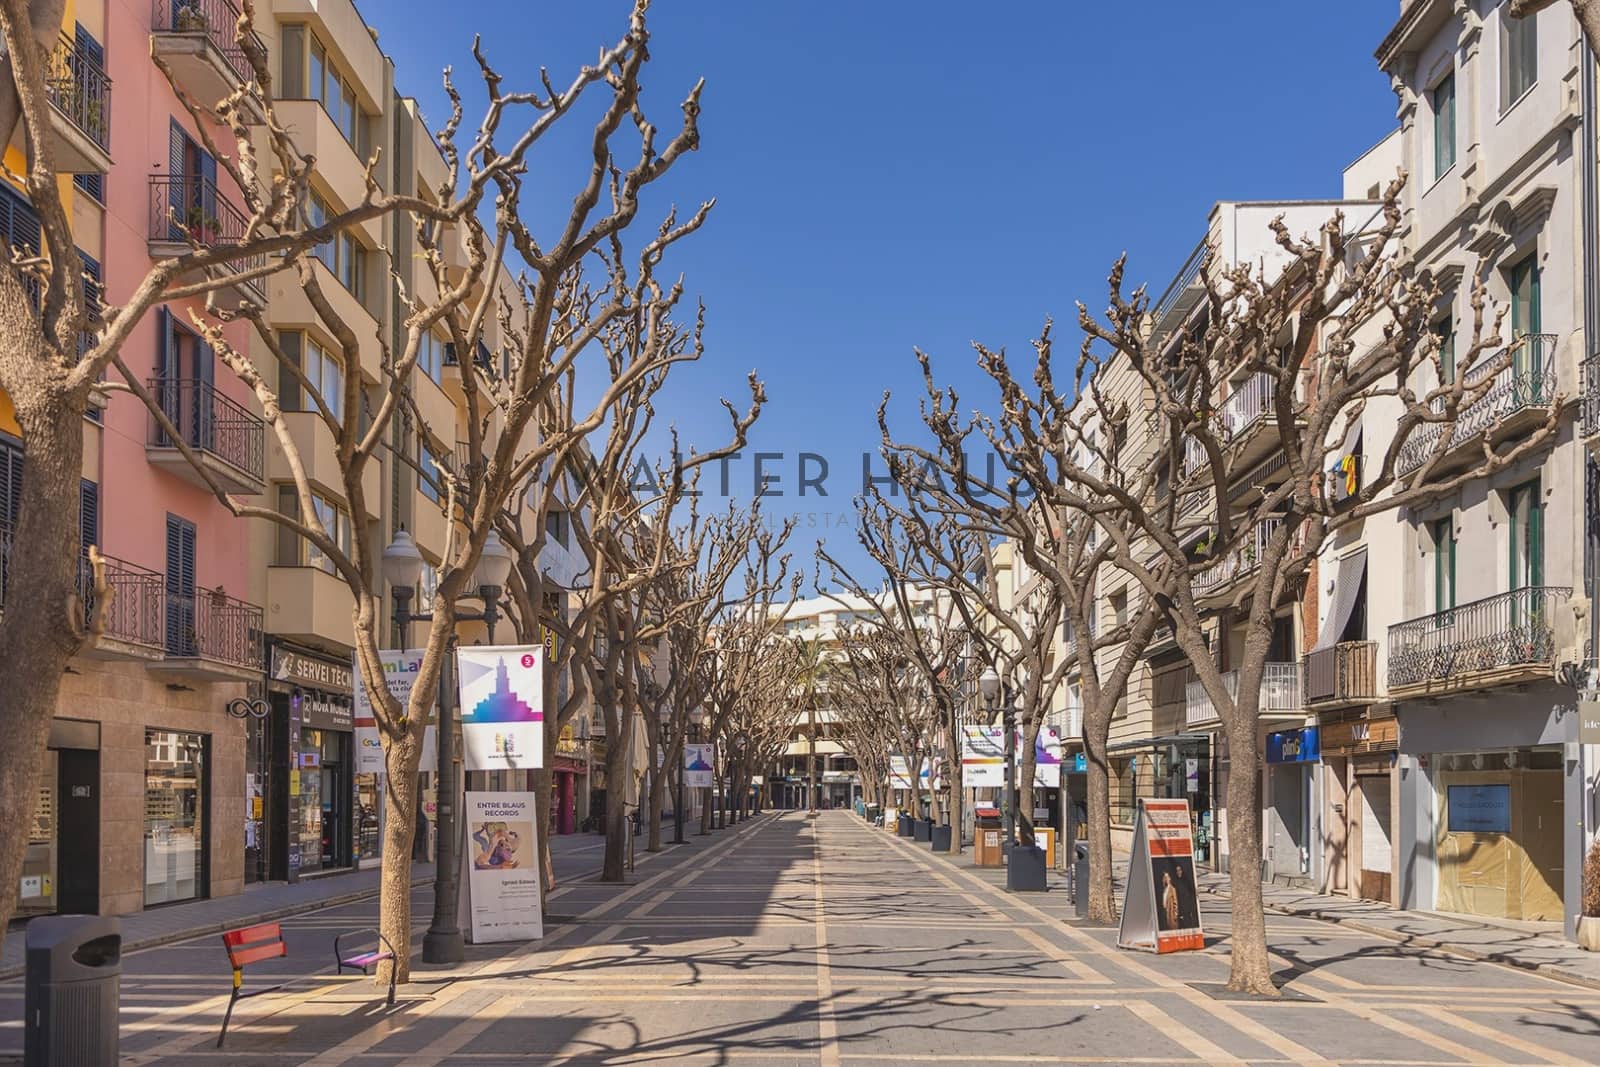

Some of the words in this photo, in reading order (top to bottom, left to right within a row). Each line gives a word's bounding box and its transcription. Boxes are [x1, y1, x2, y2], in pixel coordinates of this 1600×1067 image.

[296, 659, 329, 683] SERVEI
[312, 701, 329, 713] NOVA
[502, 801, 526, 809] BLAUS
[484, 809, 519, 817] RECORDS
